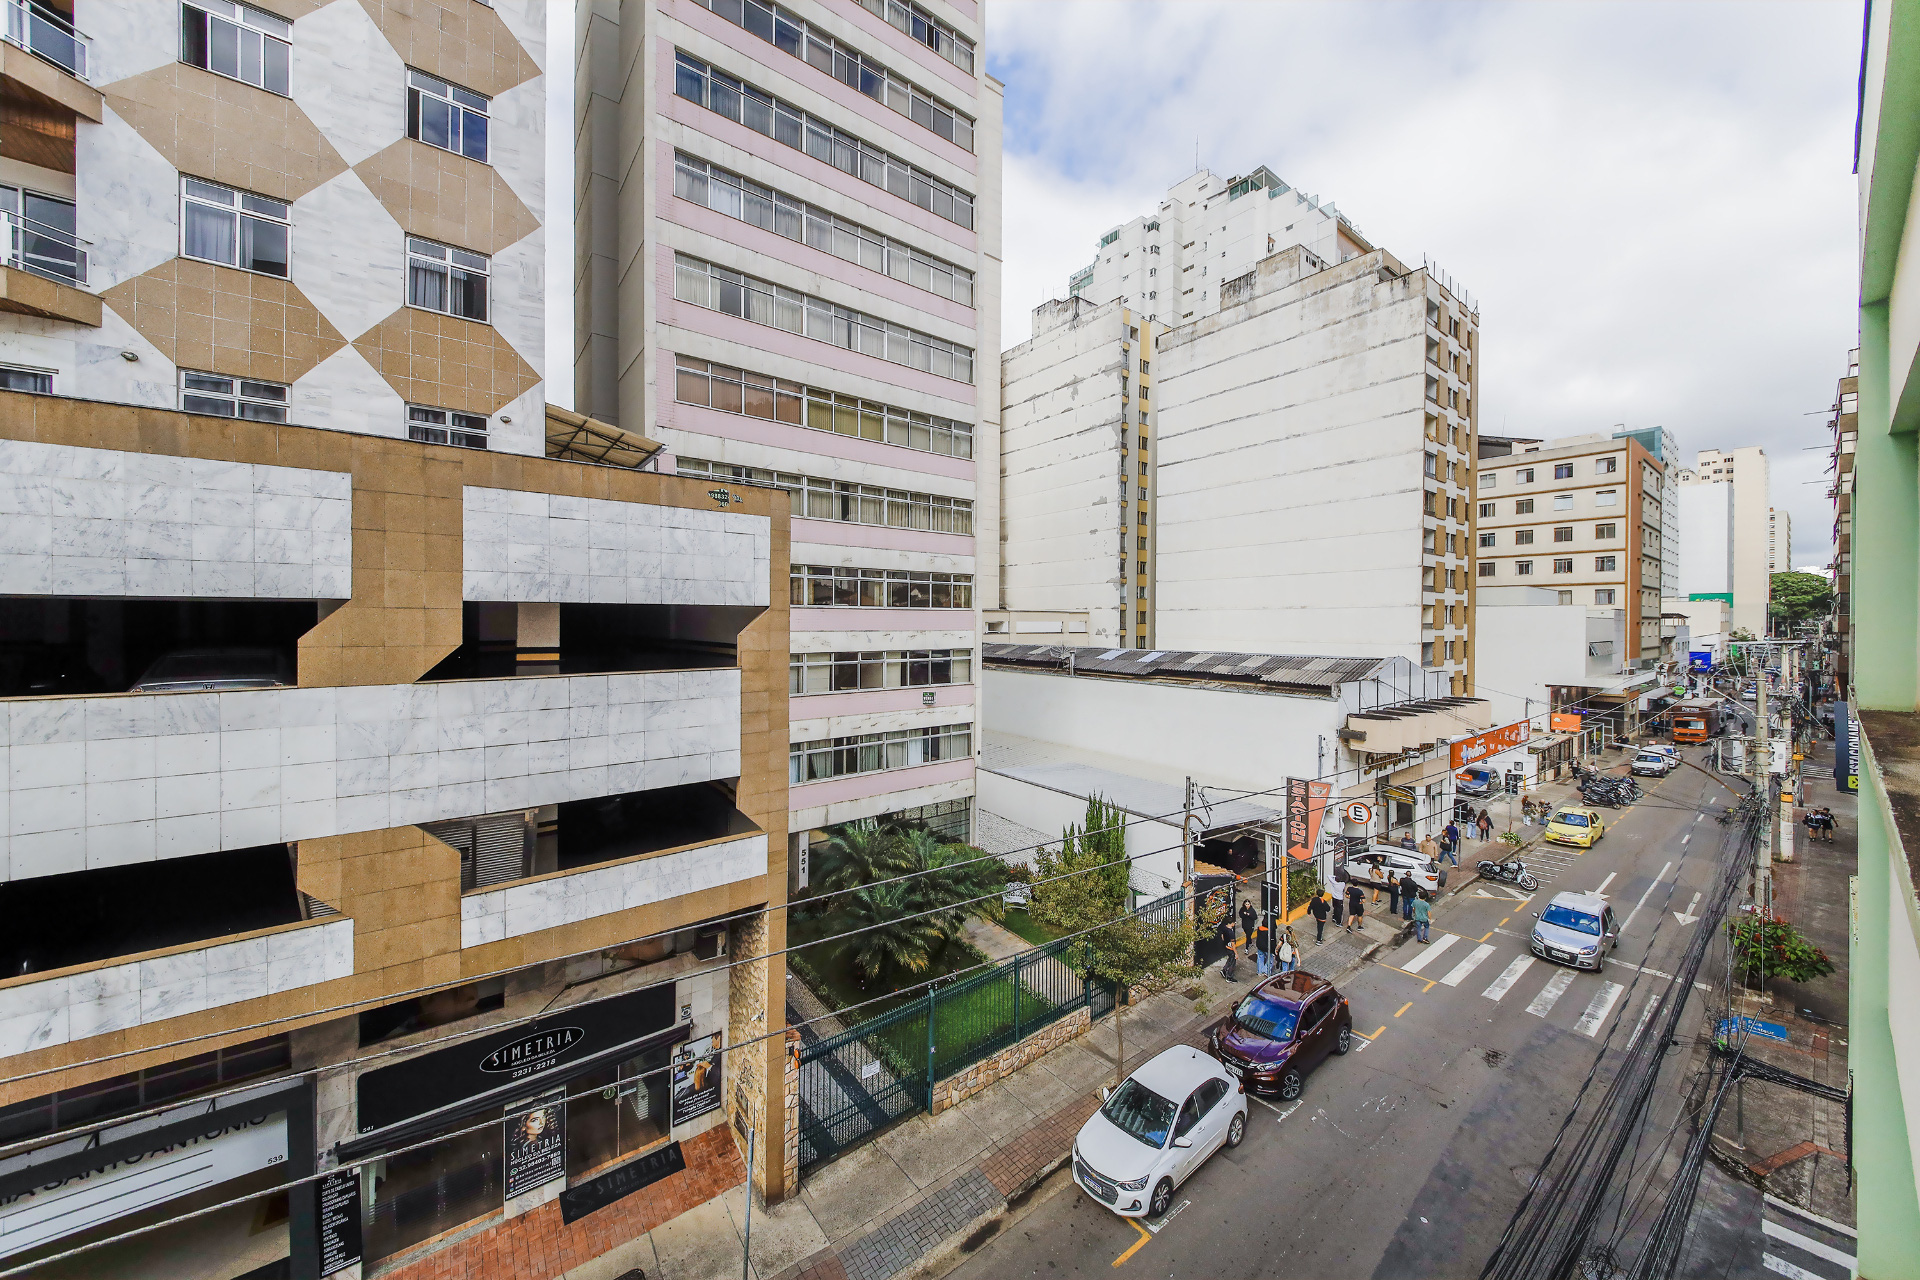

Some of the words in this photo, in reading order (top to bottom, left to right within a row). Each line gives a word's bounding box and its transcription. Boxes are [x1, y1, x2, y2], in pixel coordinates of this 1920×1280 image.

[493, 1031, 571, 1066] SIMETRIA
[512, 1059, 556, 1078] 3231-2218
[267, 1154, 284, 1165] 539
[510, 1134, 561, 1160] SIMETRIA
[596, 1149, 677, 1195] SIMETRIA
